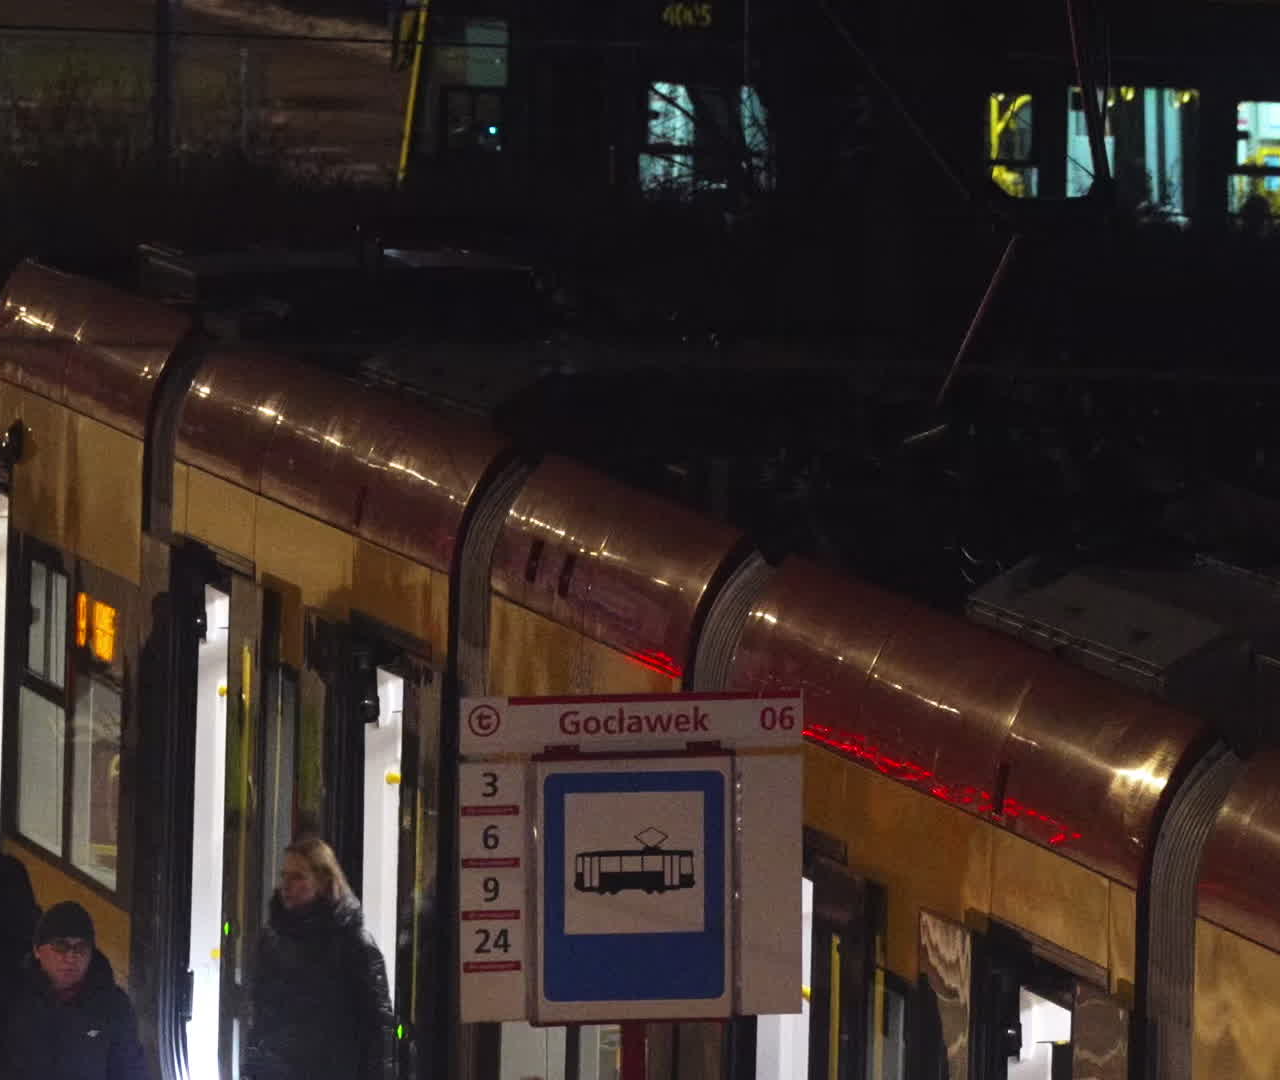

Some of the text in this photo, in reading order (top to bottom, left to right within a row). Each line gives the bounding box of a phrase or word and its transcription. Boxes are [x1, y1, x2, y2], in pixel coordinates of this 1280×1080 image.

[559, 707, 710, 735] Gocławek
[760, 706, 795, 731] 06
[482, 773, 499, 798] 3
[482, 824, 500, 850] 6
[482, 877, 500, 902] 9
[474, 929, 511, 953] 24
